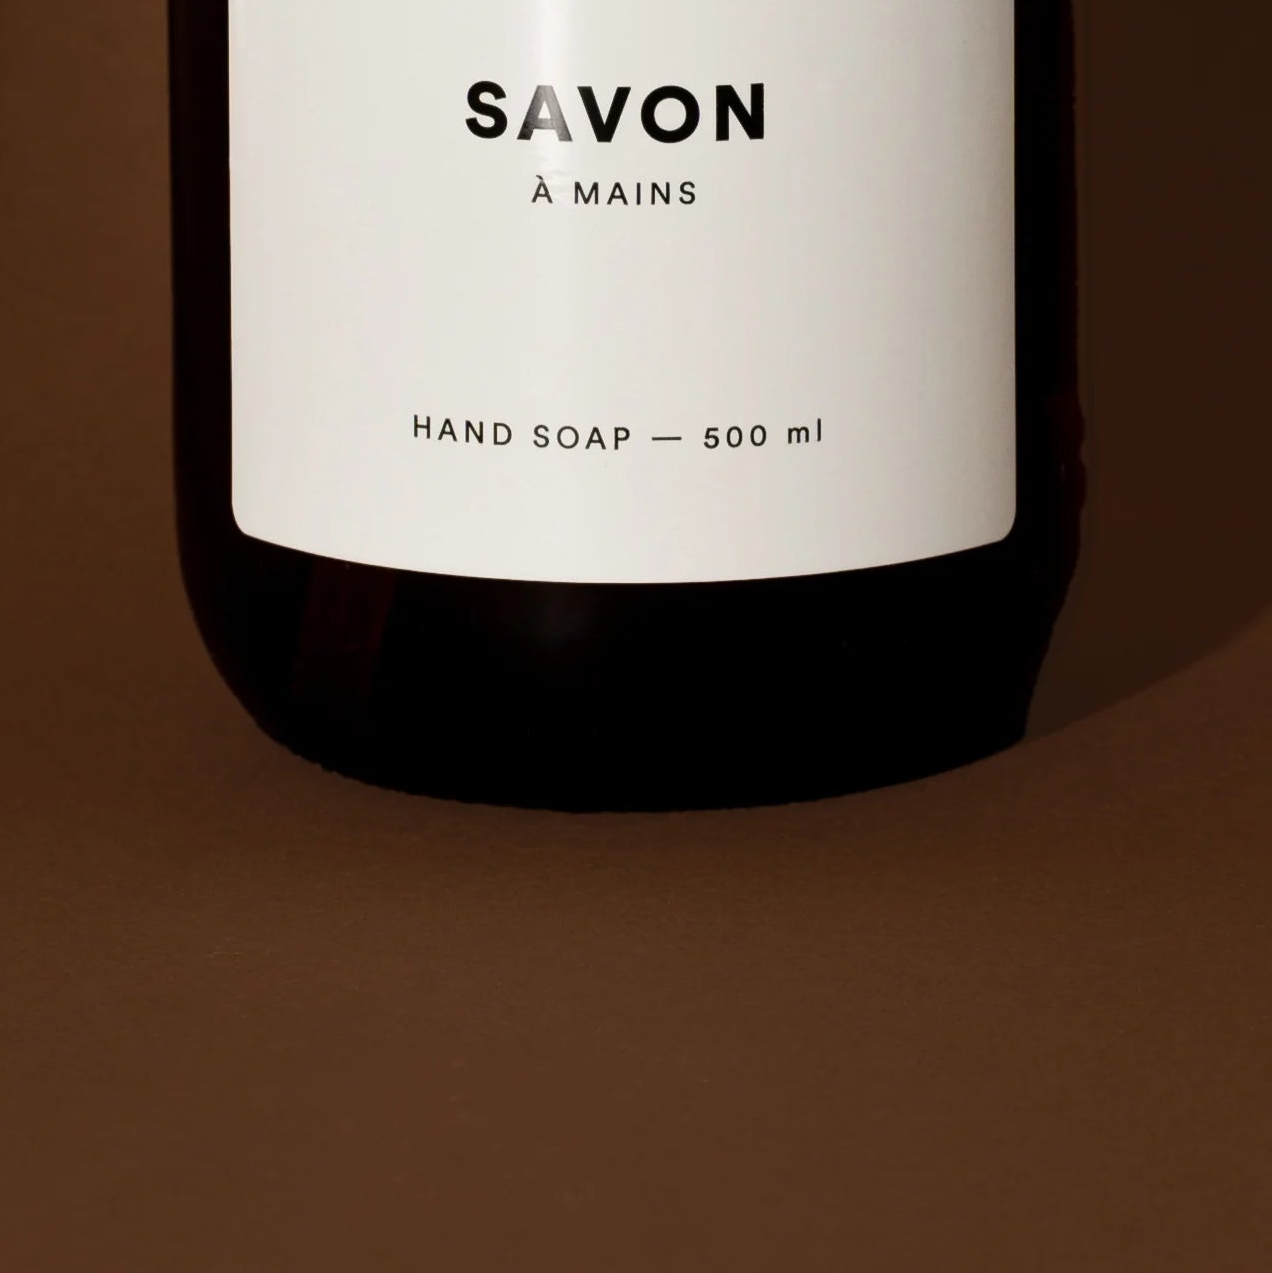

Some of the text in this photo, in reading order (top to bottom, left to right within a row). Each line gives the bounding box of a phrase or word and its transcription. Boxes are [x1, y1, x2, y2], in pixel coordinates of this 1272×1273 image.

[465, 80, 765, 144] SAVON
[531, 174, 697, 206] À MAINS
[413, 414, 513, 446] HAND
[532, 424, 632, 451] SOAP
[703, 424, 769, 450] 500
[787, 417, 823, 445] ml
